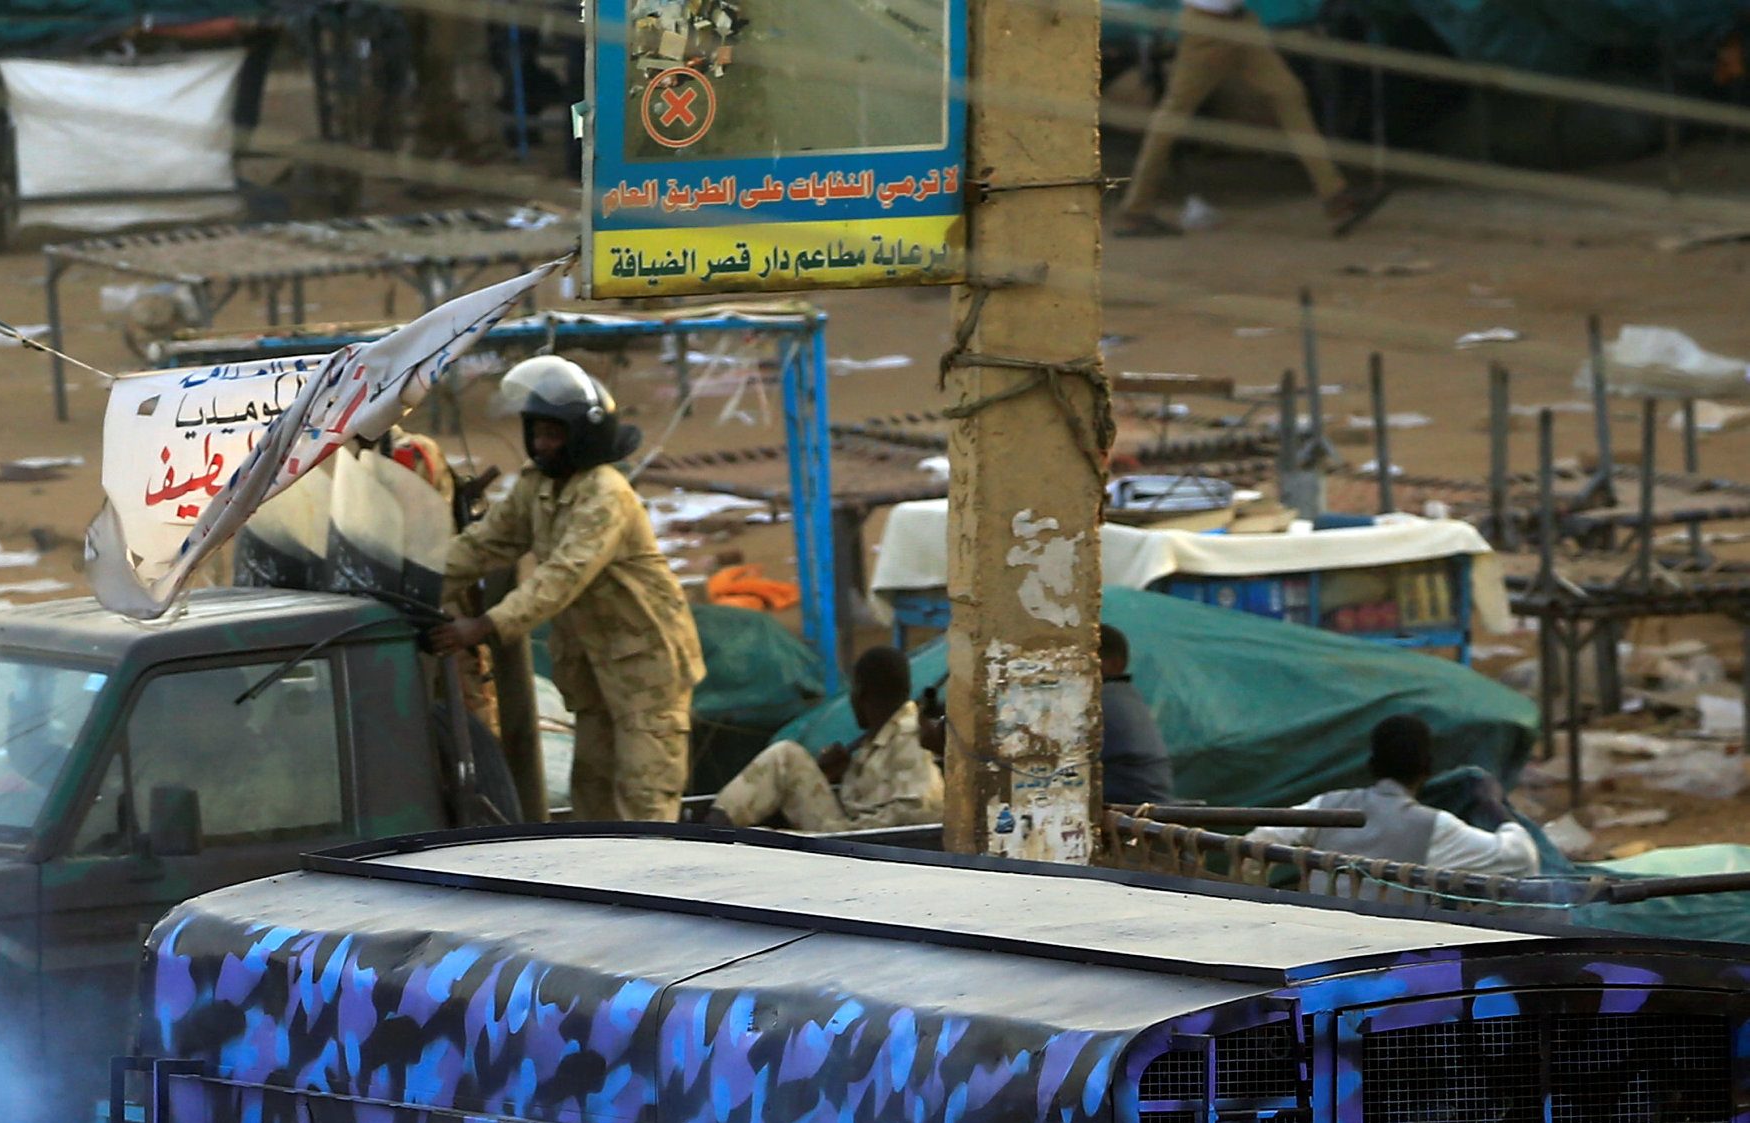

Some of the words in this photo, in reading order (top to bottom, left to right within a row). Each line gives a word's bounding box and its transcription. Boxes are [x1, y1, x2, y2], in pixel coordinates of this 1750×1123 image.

[661, 175, 736, 213] الطريق
[738, 174, 785, 209] على
[788, 168, 875, 206] النفايات
[877, 169, 941, 209] ترمي
[943, 164, 959, 194] لا
[601, 178, 659, 220] العام
[610, 247, 697, 287] الضيافة
[700, 242, 752, 282] قصر
[757, 244, 791, 278] دار
[794, 237, 867, 281] مطاعم
